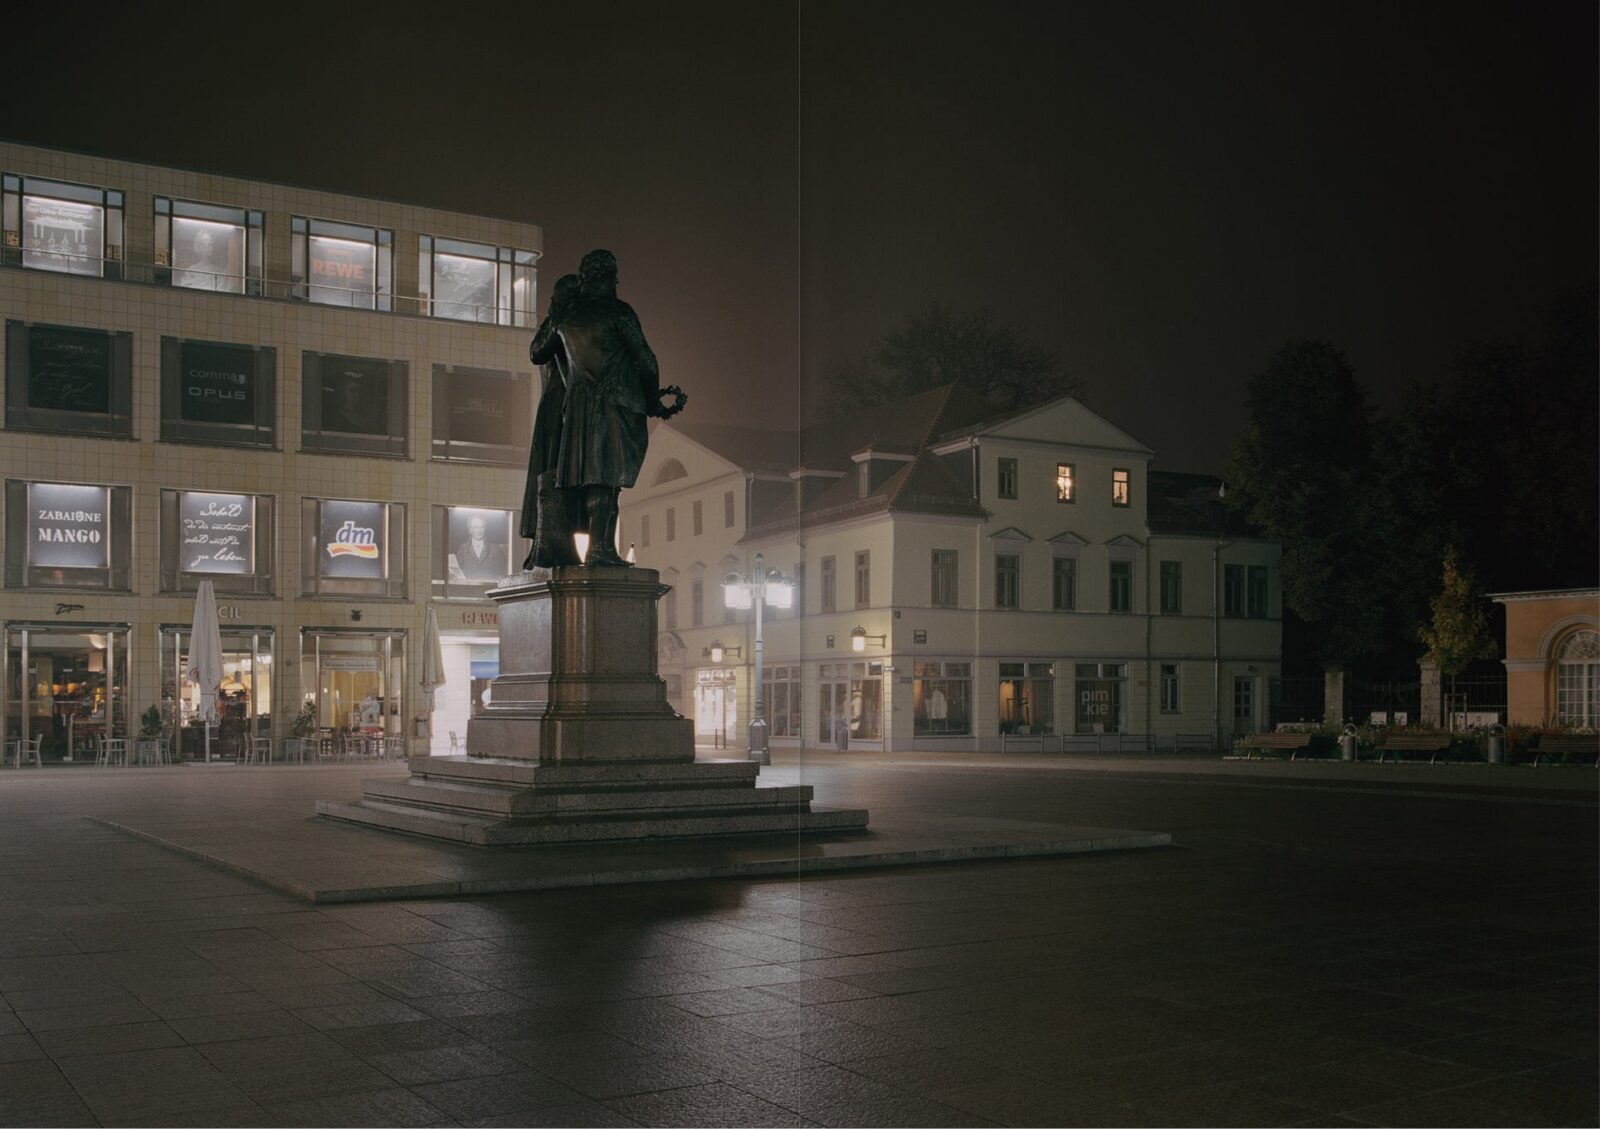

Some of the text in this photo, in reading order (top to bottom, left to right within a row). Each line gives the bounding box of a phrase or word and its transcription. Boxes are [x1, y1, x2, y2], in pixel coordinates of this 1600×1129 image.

[313, 259, 364, 279] REWE
[188, 386, 246, 400] OPUS
[38, 510, 102, 523] ZABAIONE
[38, 528, 101, 544] MANGO
[336, 521, 374, 544] dm
[218, 606, 242, 618] CIL
